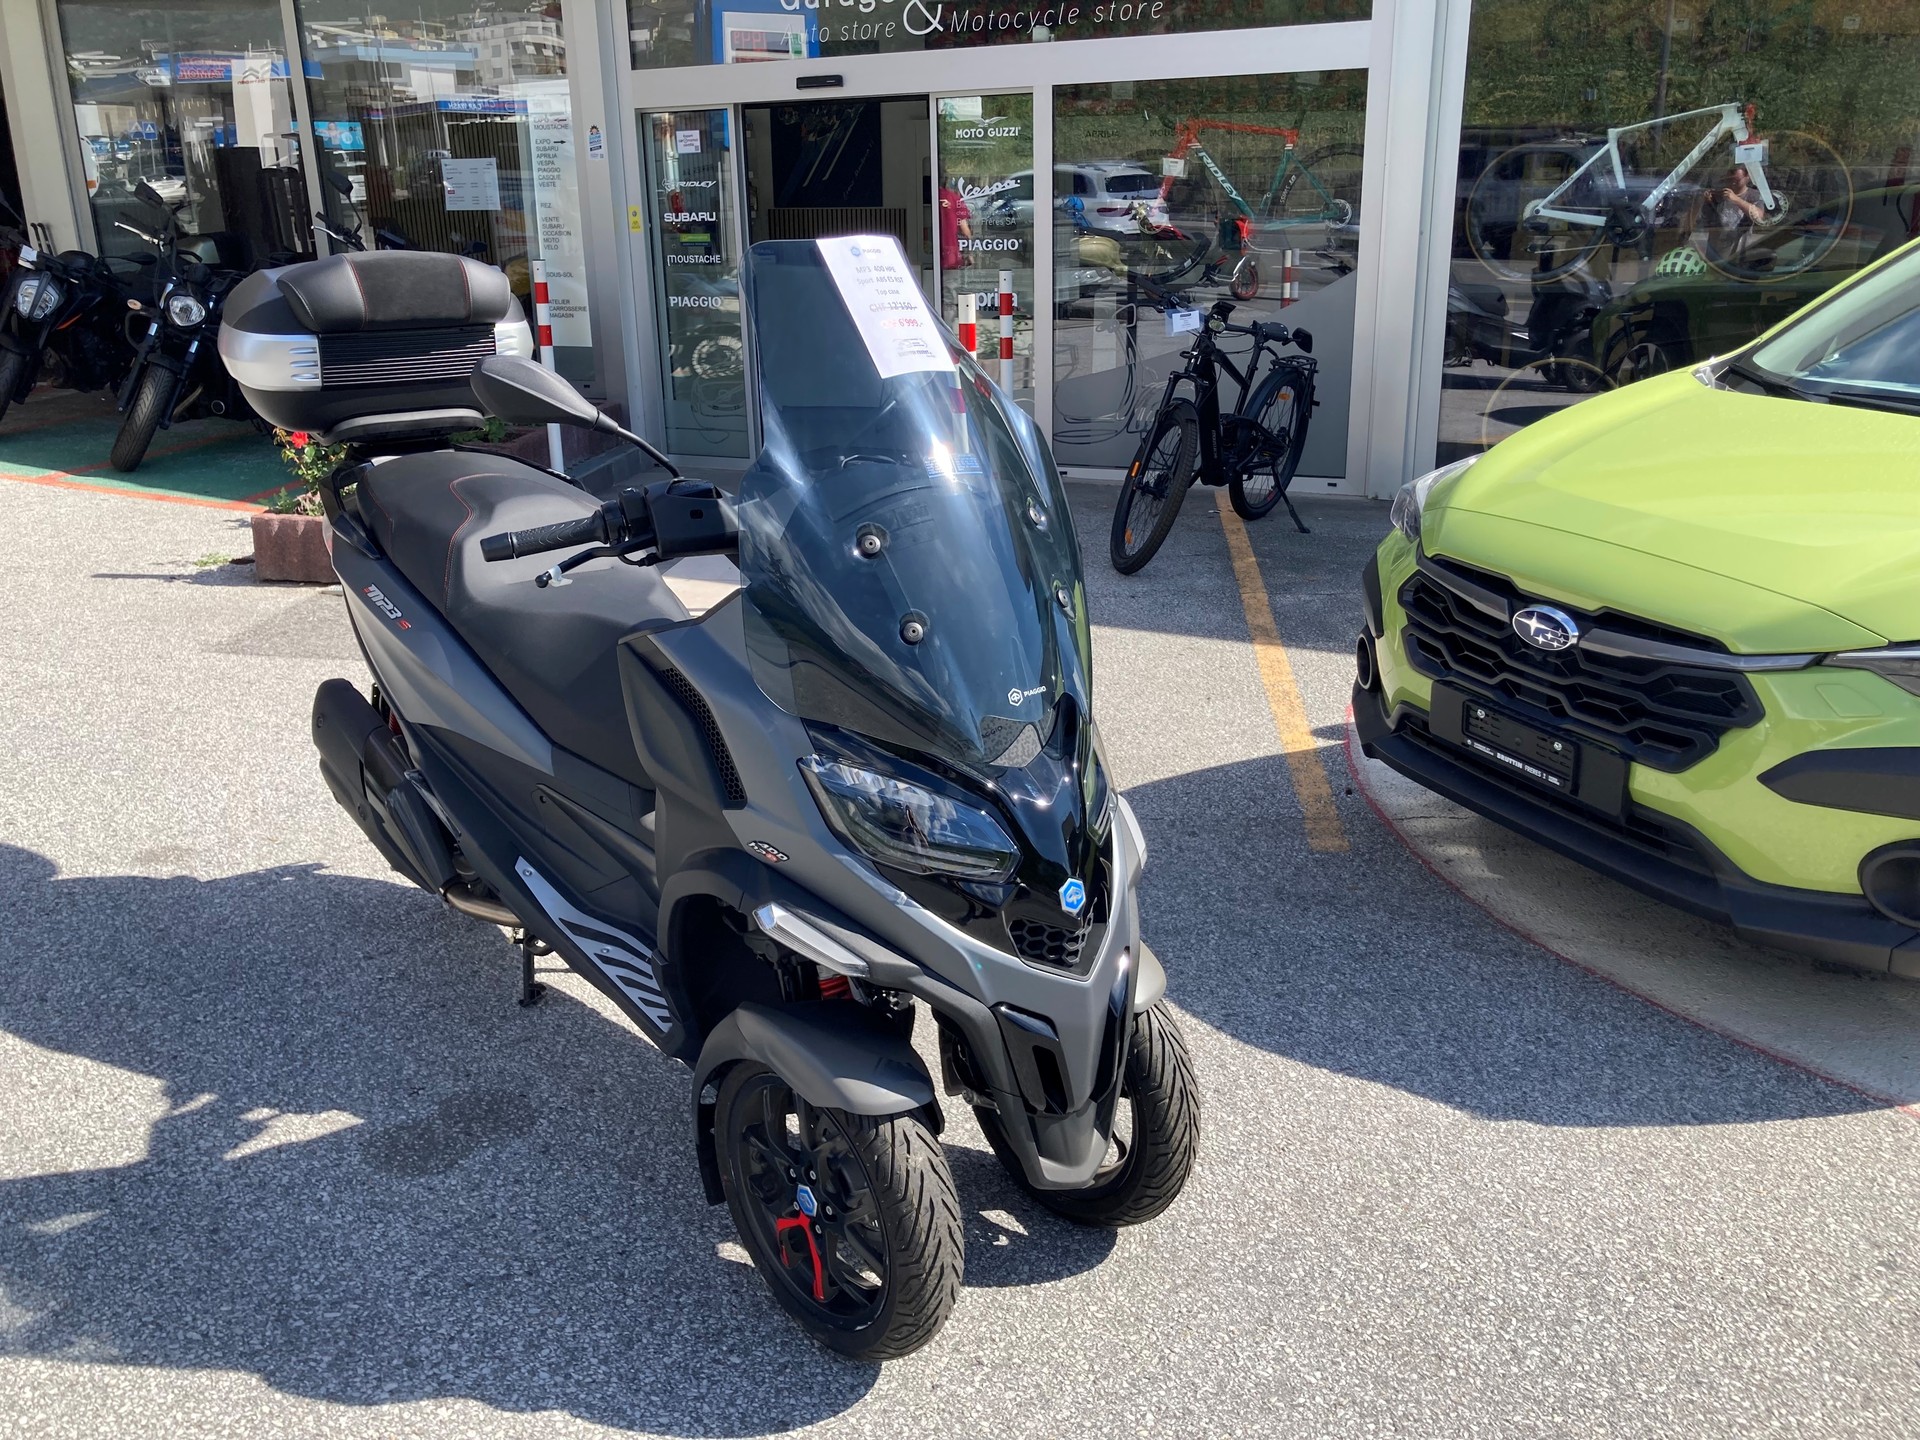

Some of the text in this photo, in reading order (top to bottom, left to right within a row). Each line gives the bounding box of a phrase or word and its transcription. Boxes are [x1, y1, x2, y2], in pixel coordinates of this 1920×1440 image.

[841, 20, 896, 42] store
[902, 0, 944, 35] &
[951, 3, 1080, 34] Motocycle
[1094, 1, 1164, 23] store
[955, 126, 1020, 139] MOTO GUZZI
[1197, 151, 1243, 201] RIDLEY
[676, 180, 717, 189] RIDLEY
[957, 176, 1021, 201] Vespa
[663, 211, 717, 222] SUBARU
[1005, 217, 1017, 226] SA
[957, 238, 1020, 251] PIAGGIO
[667, 254, 722, 267] MOUSTACHE
[875, 288, 888, 296] Top
[669, 296, 722, 308] PIAGGIO
[975, 287, 1018, 311] pria
[1023, 685, 1047, 697] PIAGGIO
